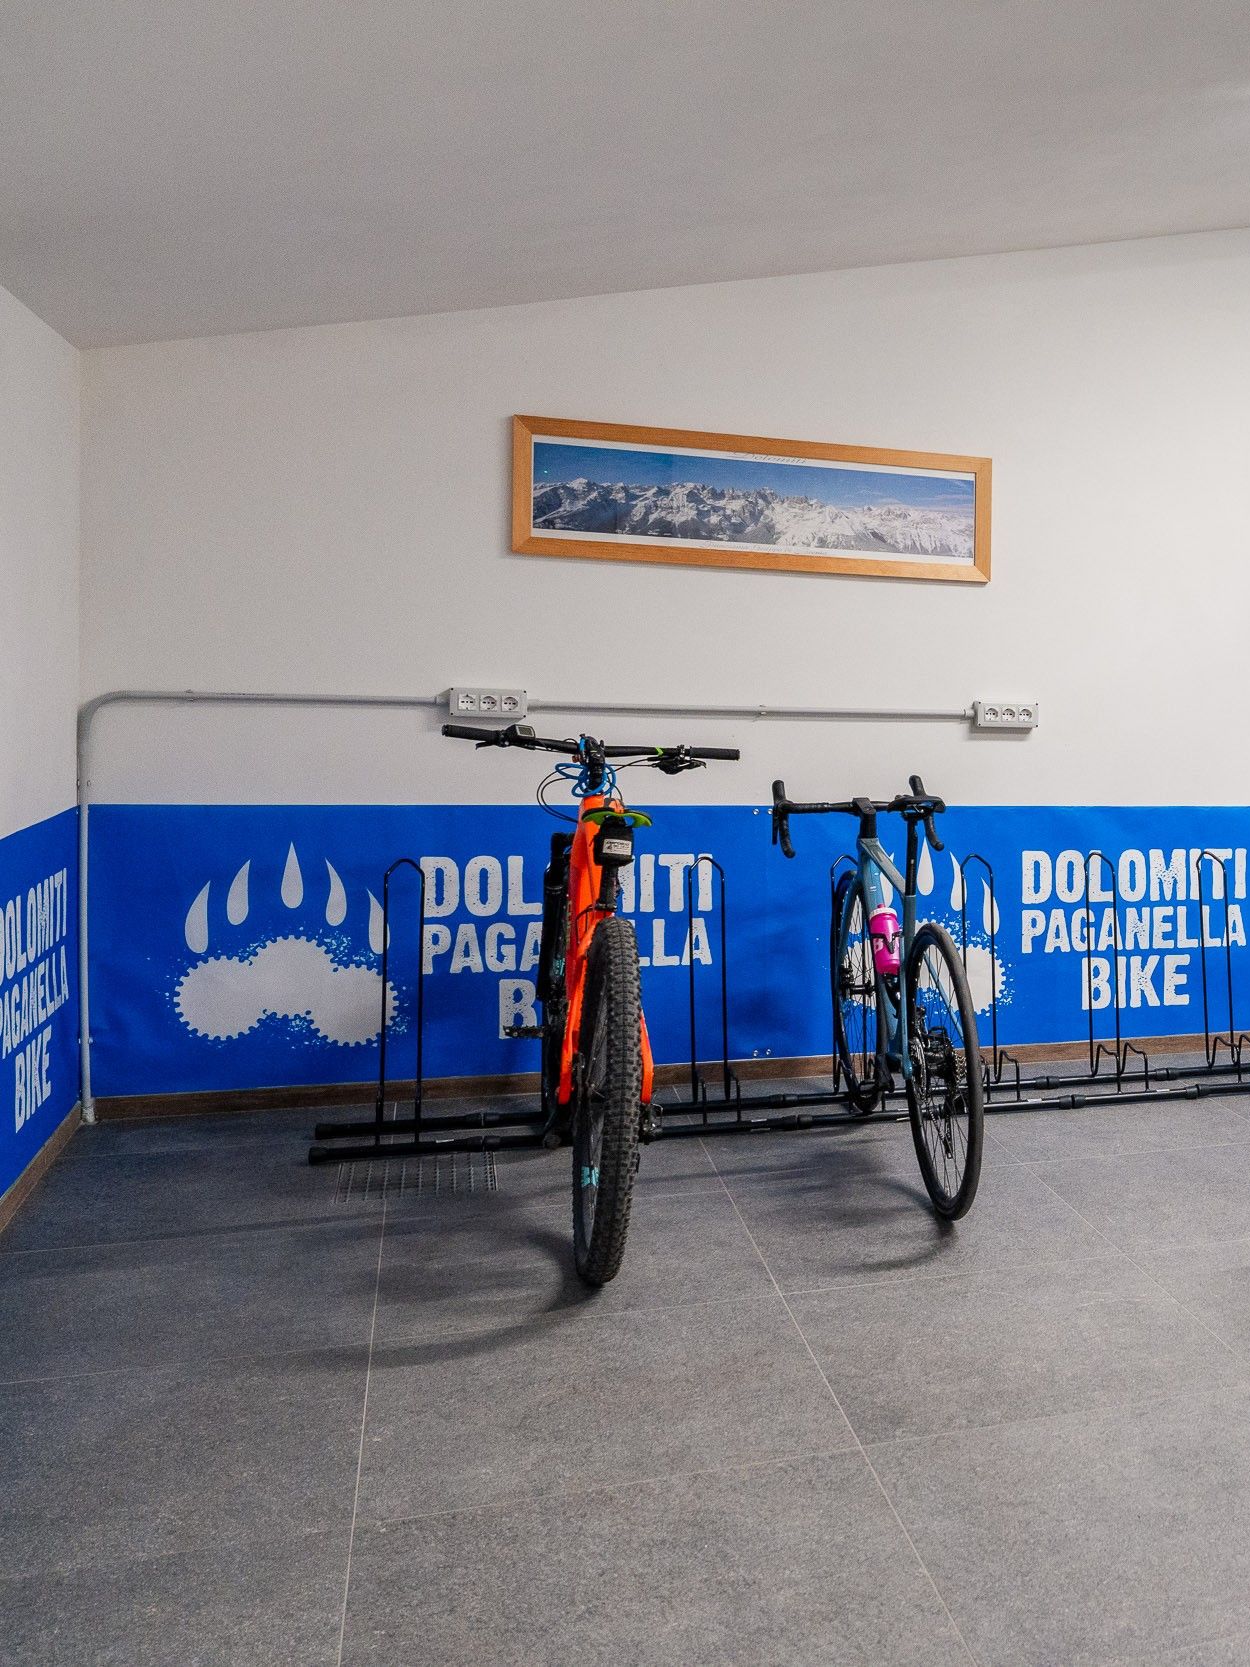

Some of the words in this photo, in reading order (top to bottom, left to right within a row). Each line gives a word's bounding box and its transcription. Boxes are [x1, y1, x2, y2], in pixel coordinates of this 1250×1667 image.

[419, 853, 713, 918] DOLITI
[1021, 848, 1247, 905] DOLOMITI
[421, 918, 712, 975] PAGALA
[1021, 904, 1247, 954] PAGANELLA
[0, 945, 69, 1059] AGANELLA
[1081, 954, 1191, 1010] BIKE
[15, 1024, 52, 1133] BIKE
